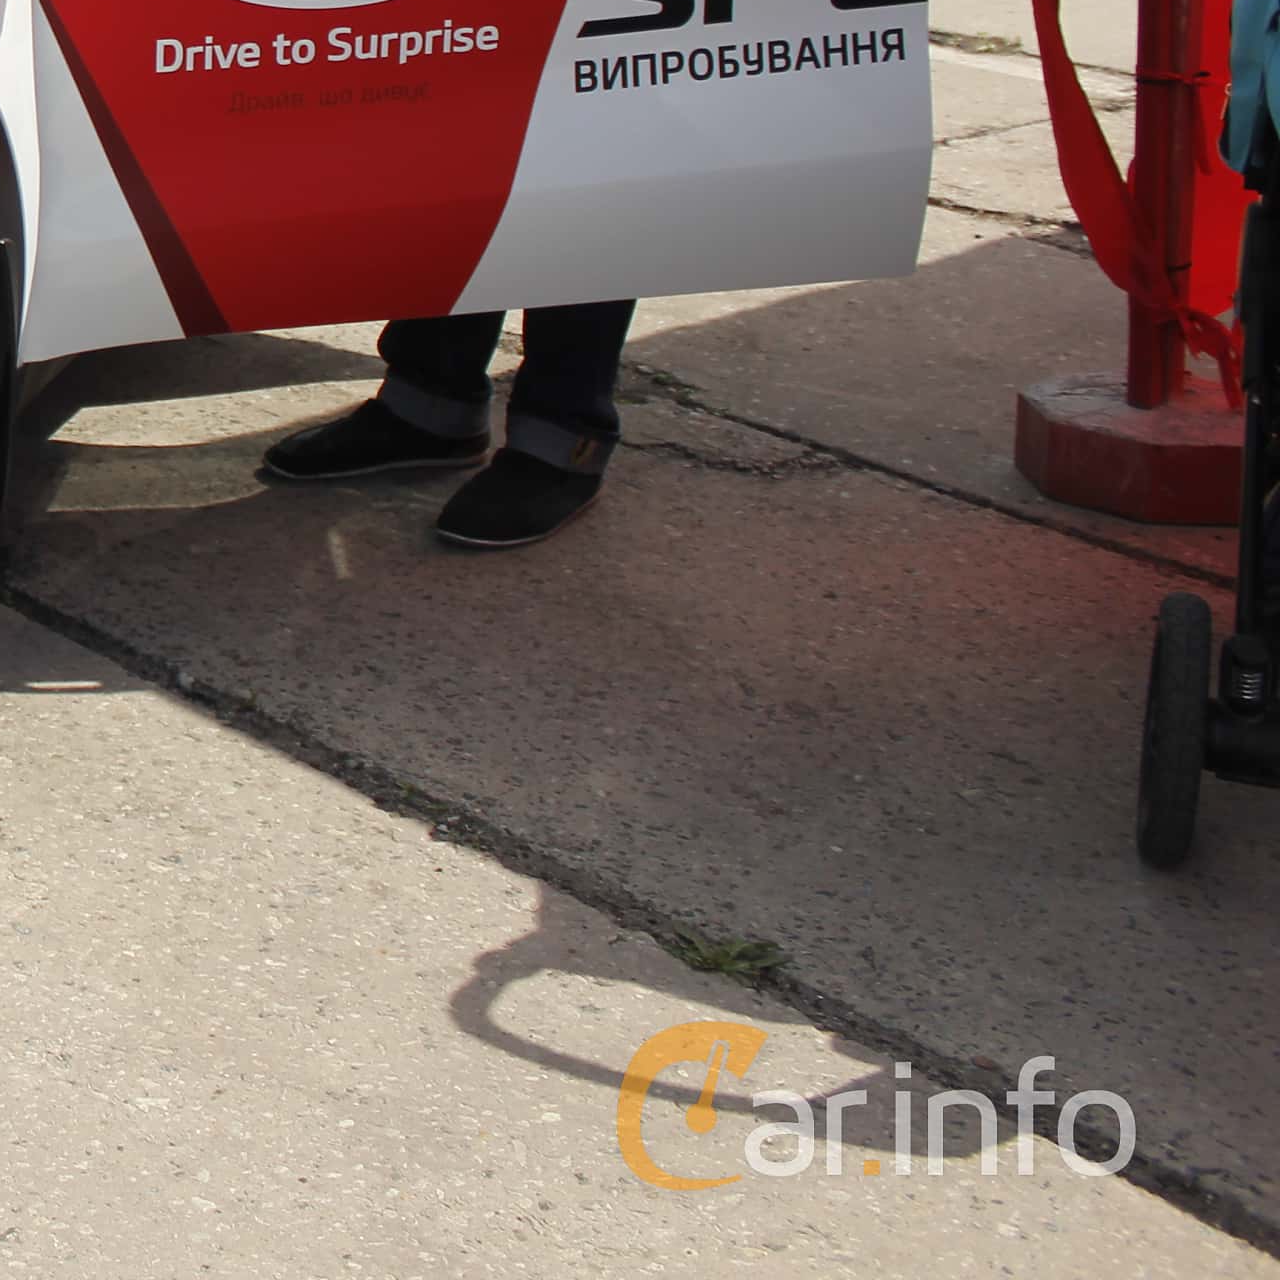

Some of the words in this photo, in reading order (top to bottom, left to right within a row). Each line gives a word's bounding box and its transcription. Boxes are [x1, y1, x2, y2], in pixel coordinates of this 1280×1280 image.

[155, 36, 261, 73] Drive
[273, 33, 316, 66] to
[327, 20, 500, 64] Surprise
[574, 28, 905, 93] ВИПРОБУВАННЯ
